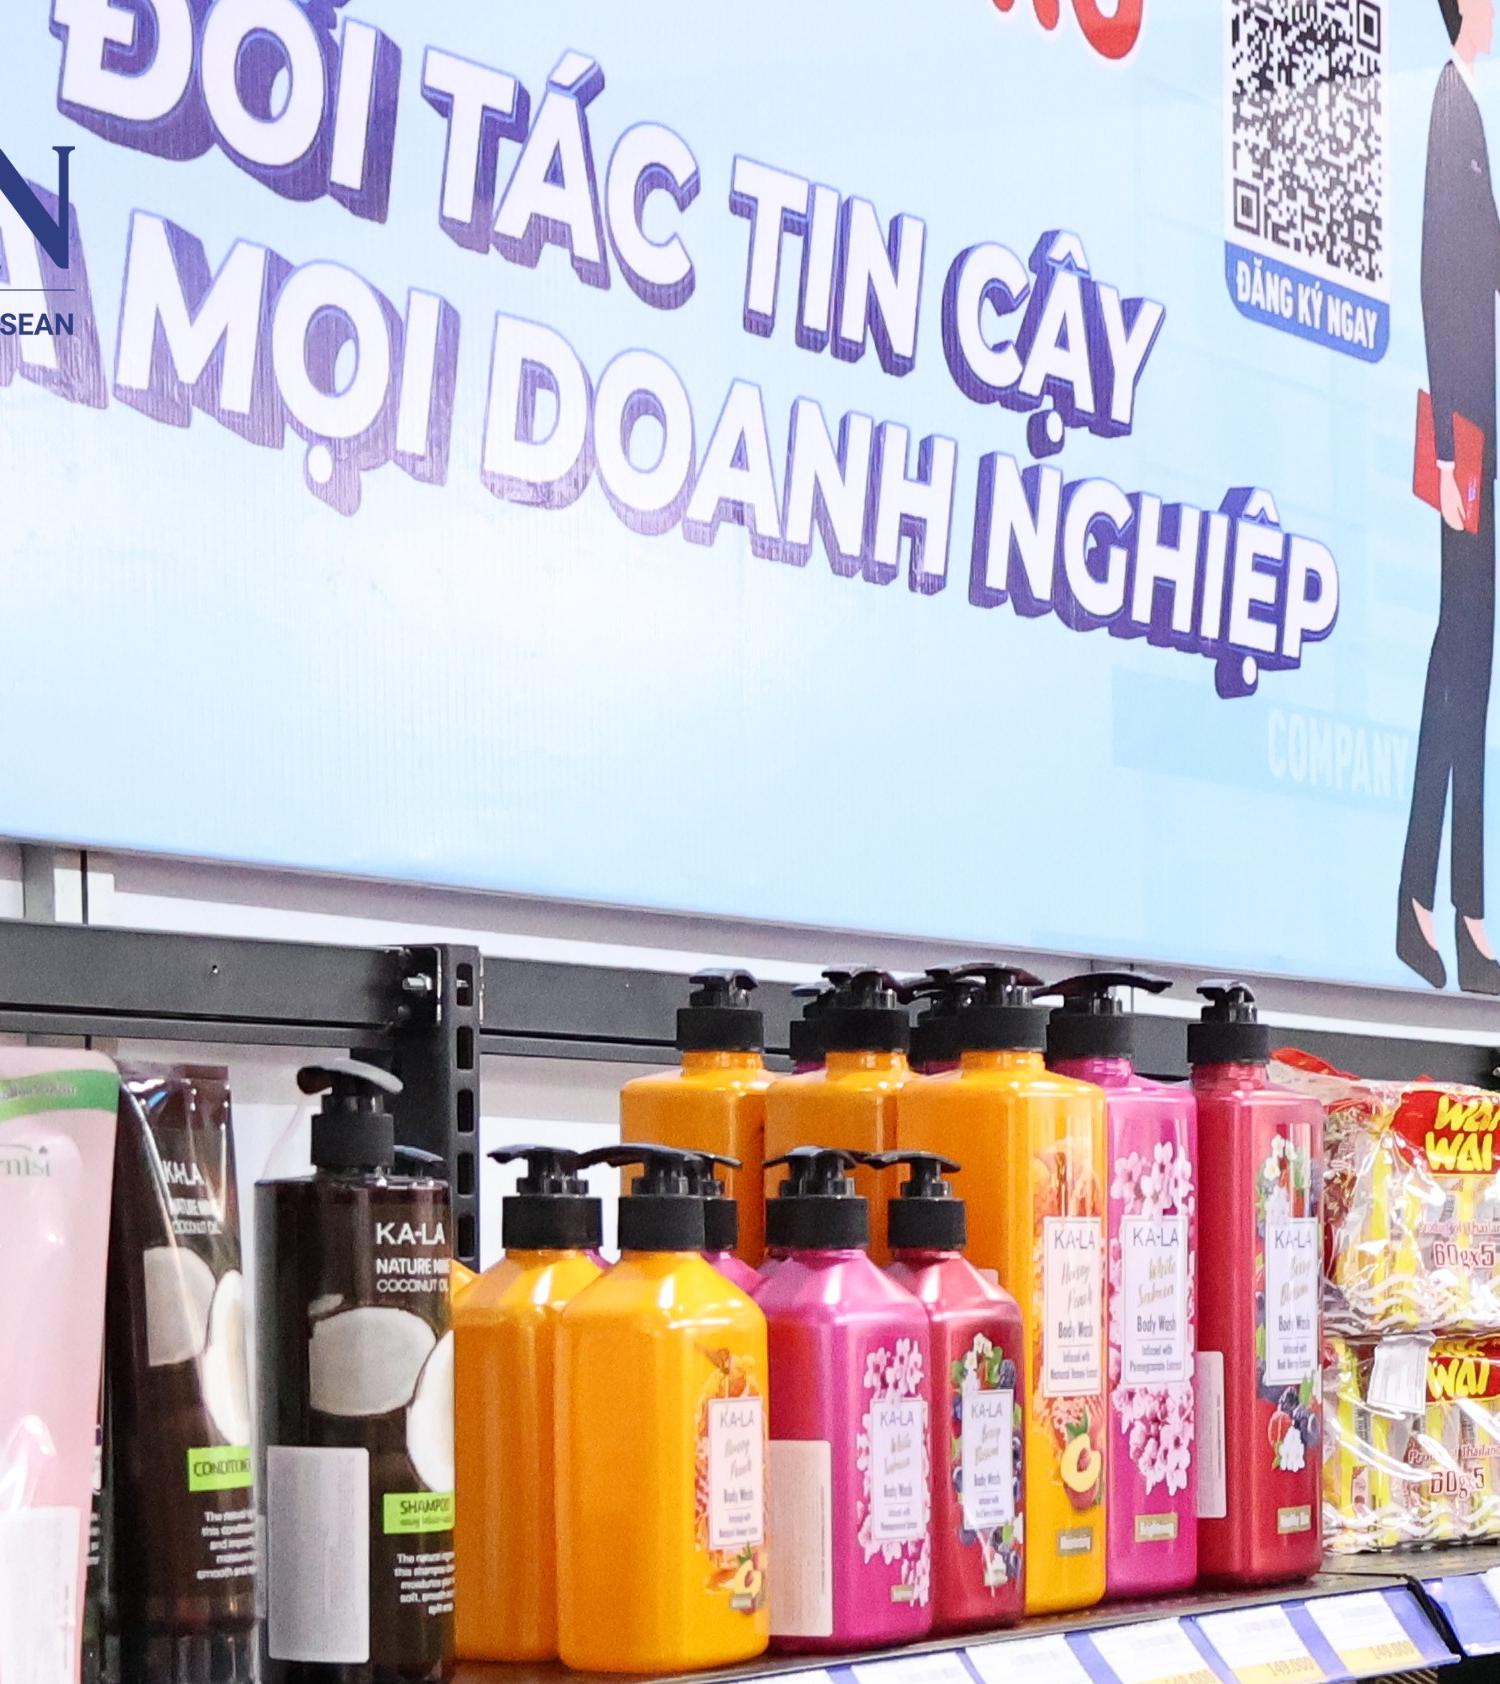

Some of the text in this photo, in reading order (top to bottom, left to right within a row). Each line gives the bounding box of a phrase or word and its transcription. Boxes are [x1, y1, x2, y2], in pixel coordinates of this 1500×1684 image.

[421, 45, 700, 300] TÁC
[730, 153, 926, 374] TIN
[943, 230, 1166, 456] CẬY
[1235, 257, 1379, 352] ĐĂNG KÝ NGAY
[112, 207, 455, 508] MỌI
[481, 310, 958, 592] DOANH
[969, 450, 1341, 698] NGHIỆP
[1267, 707, 1410, 800] COMPANY
[1425, 1132, 1494, 1173] WAI
[375, 1221, 446, 1246] KA-LA
[1053, 1229, 1097, 1251] KA-LA
[1132, 1227, 1180, 1248] KA-LA
[1274, 1230, 1313, 1250] KA-LA
[375, 1258, 432, 1275] NATURE
[376, 1278, 438, 1293] COCONUT
[1058, 1320, 1095, 1342] Body Wash
[1137, 1313, 1177, 1335] Body Wash
[1296, 1313, 1312, 1332] Wash
[719, 1410, 756, 1429] KA-LA
[879, 1410, 916, 1428] KA-LA
[971, 1401, 1003, 1419] KA-LA
[1266, 1655, 1315, 1677] 149.000
